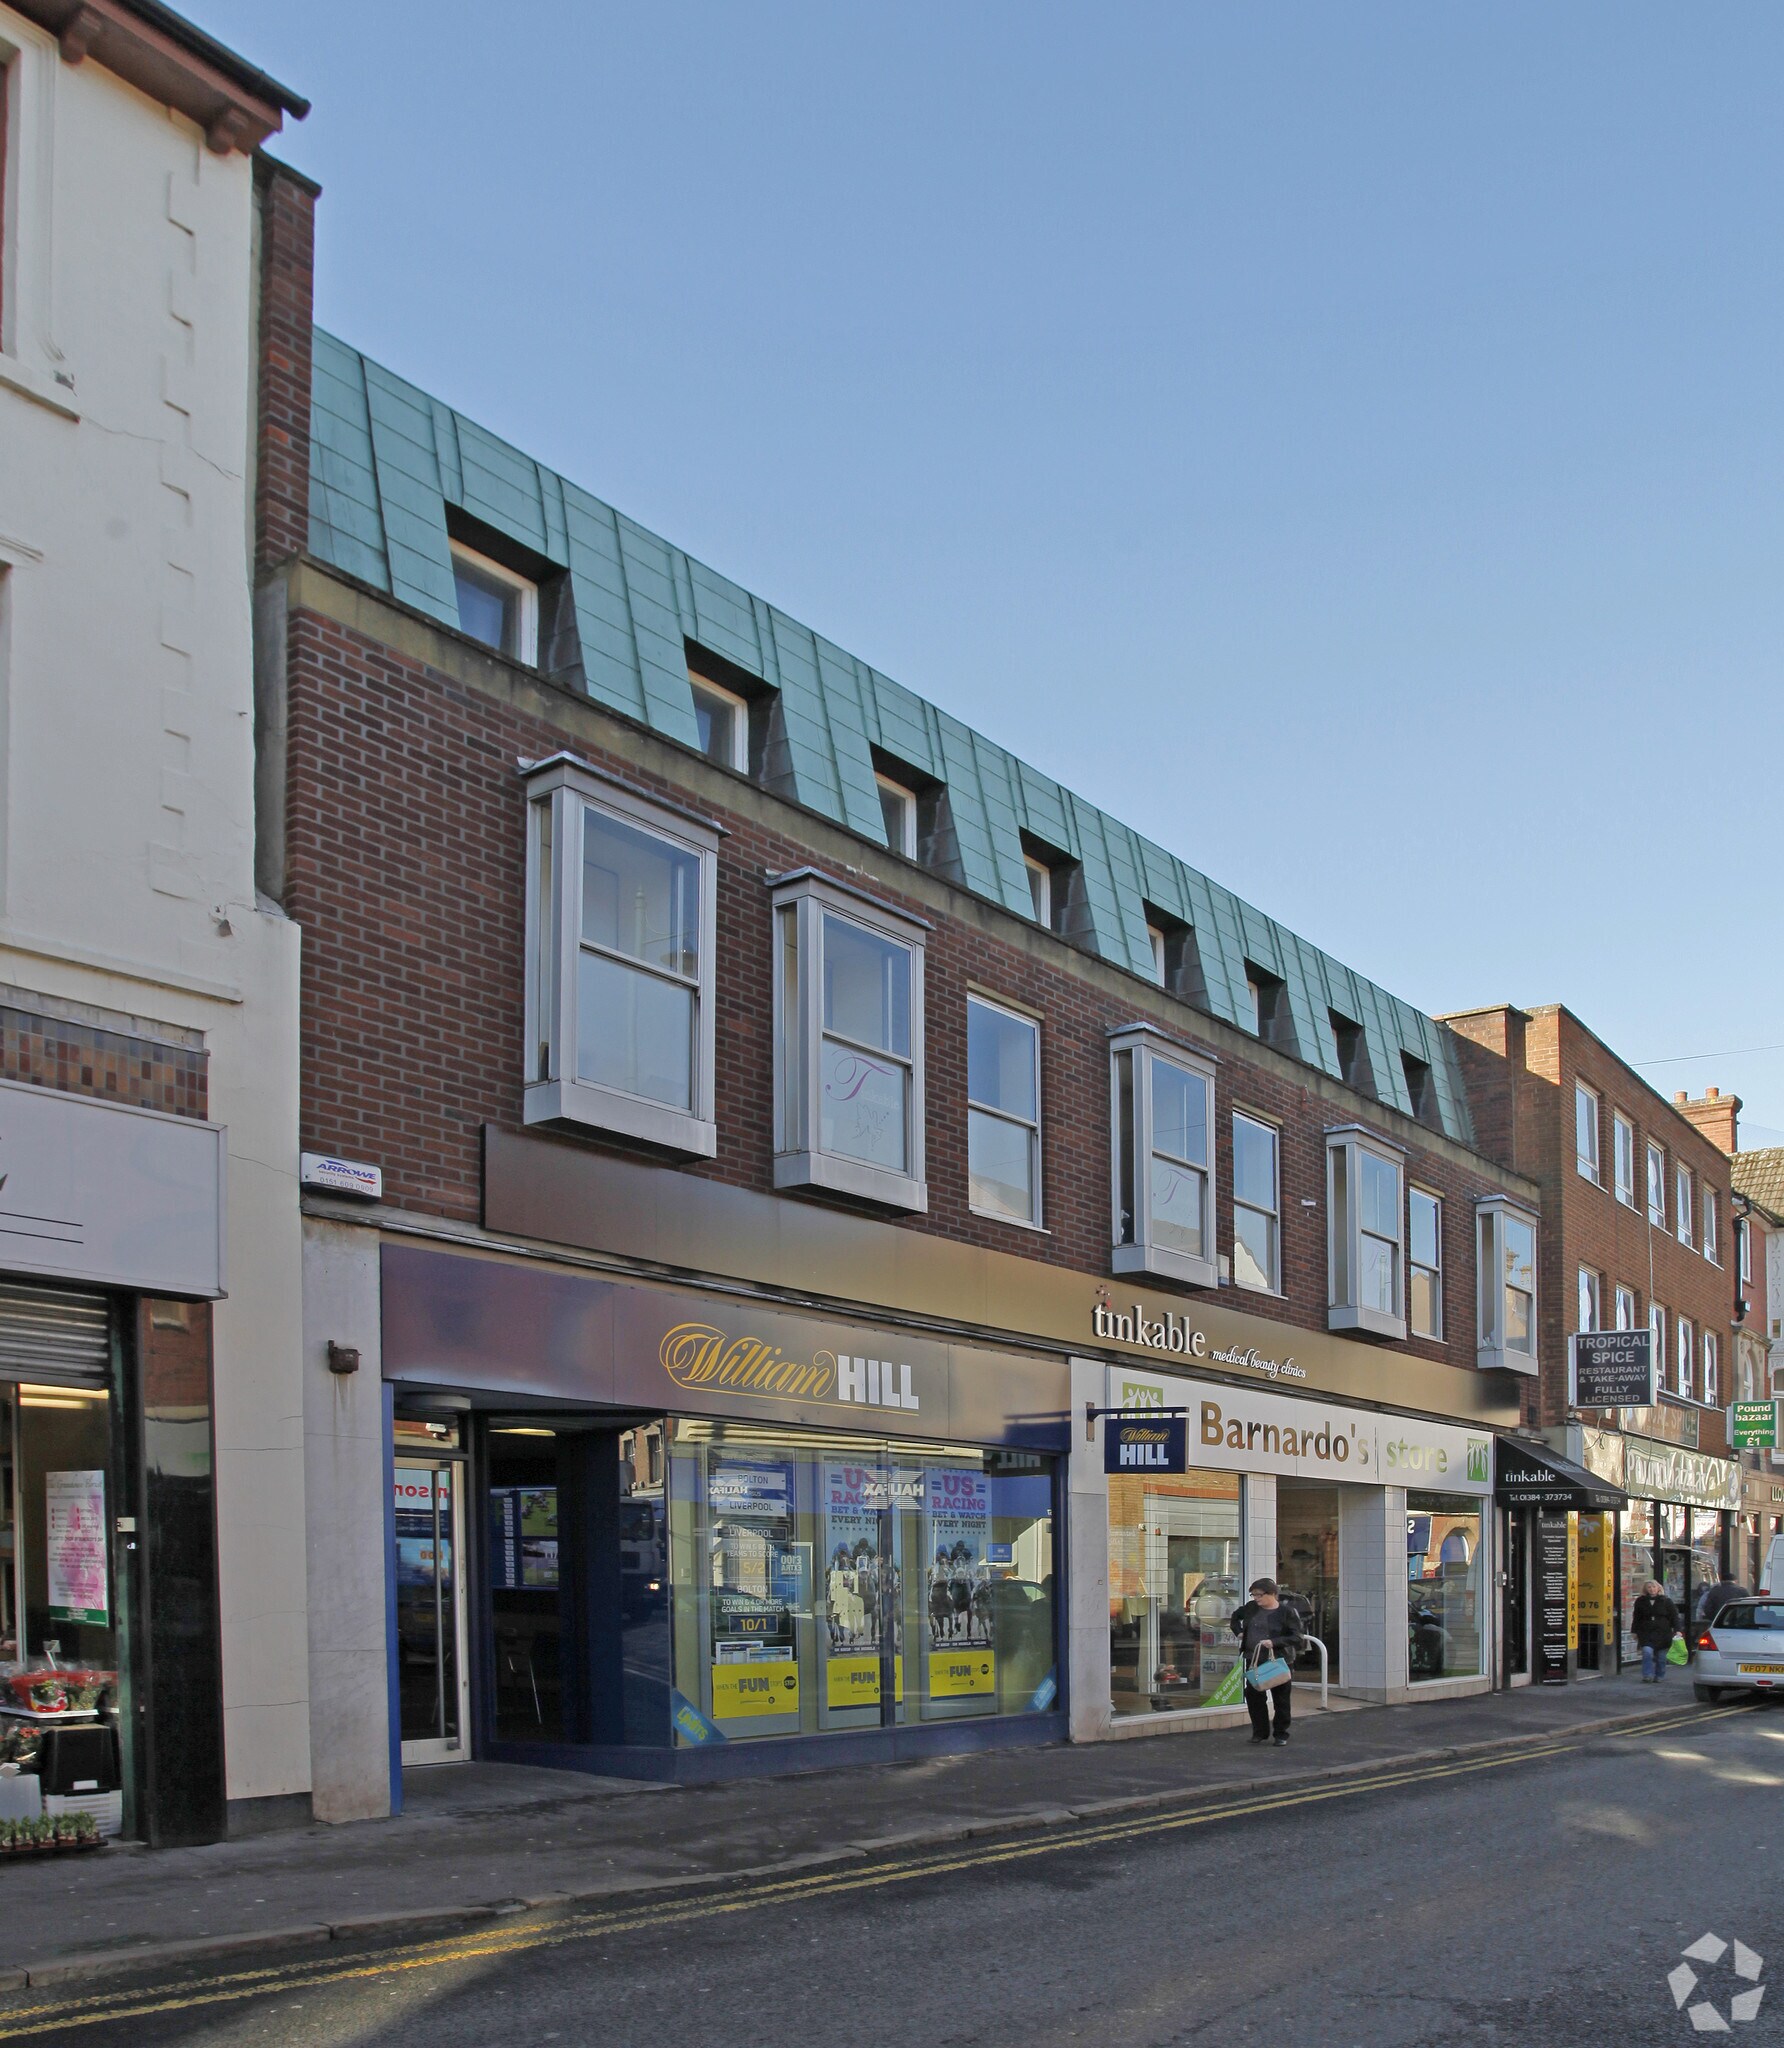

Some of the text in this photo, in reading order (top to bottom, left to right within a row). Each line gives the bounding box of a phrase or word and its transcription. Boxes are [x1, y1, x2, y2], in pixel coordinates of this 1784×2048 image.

[316, 1163, 376, 1179] ARROWE
[1093, 1303, 1307, 1379] tinkable medical beauty clinics
[1577, 1335, 1650, 1349] TROPICAL
[1592, 1351, 1635, 1364] SPICE
[659, 1322, 919, 1410] William HILL
[1579, 1365, 1647, 1375] RESTAURANT
[1579, 1374, 1647, 1384] & TAKE-AWAY
[1595, 1385, 1629, 1394] FULLY
[1585, 1394, 1640, 1404] LICENSED
[1737, 1404, 1771, 1413] Pound
[1735, 1413, 1773, 1422] bazaar
[1120, 1427, 1170, 1443] William
[1200, 1400, 1449, 1473] Barnardo's store
[1734, 1429, 1775, 1437] Everything
[1746, 1437, 1760, 1446] £1
[1120, 1444, 1169, 1466] HILL
[738, 1474, 769, 1485] BOLTON
[1505, 1469, 1556, 1483] tinkable
[942, 1475, 975, 1497] US
[1544, 1493, 1572, 1501] 373734
[729, 1501, 774, 1512] LIVERPOOL
[931, 1496, 986, 1510] RACING
[831, 1506, 849, 1514] BET
[932, 1510, 948, 1518] BET
[959, 1511, 986, 1520] WATCH
[831, 1515, 862, 1524] EVERY
[961, 1520, 987, 1528] NIGHT
[1541, 1521, 1567, 1529] tinkable
[729, 1526, 774, 1538] LIVERPOOL
[743, 1561, 765, 1574] 5/2
[737, 1584, 768, 1594] BOLTON
[722, 1598, 731, 1606] TO
[721, 1605, 743, 1613] GOALS
[764, 1605, 785, 1613] MATCH
[740, 1618, 768, 1631] 10/1
[949, 1665, 972, 1677] FUN
[850, 1671, 876, 1684] FUN
[738, 1677, 770, 1693] FUN
